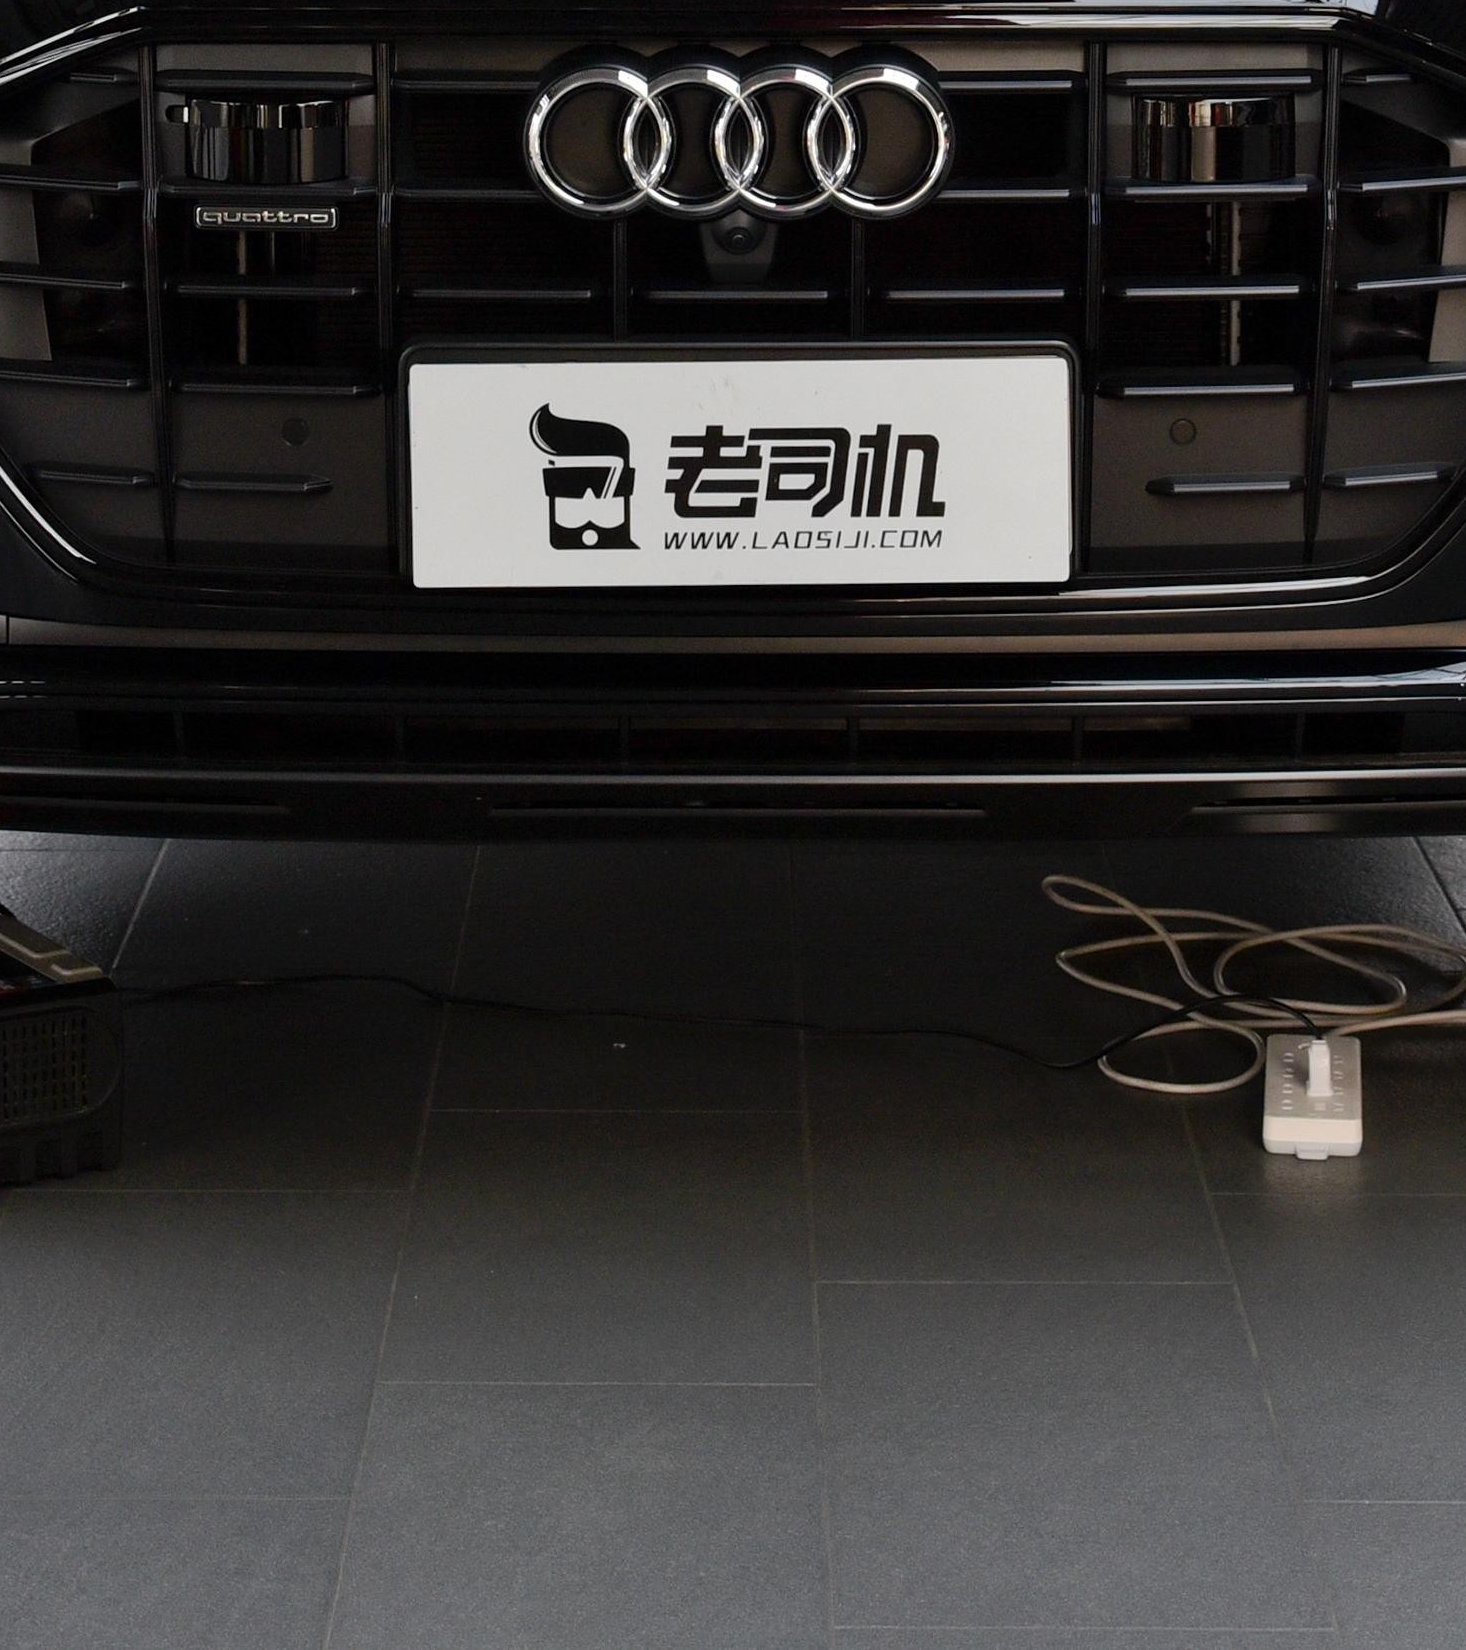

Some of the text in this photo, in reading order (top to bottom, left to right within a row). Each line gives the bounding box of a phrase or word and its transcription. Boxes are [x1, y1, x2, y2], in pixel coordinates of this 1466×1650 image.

[202, 210, 329, 225] quattro
[664, 424, 946, 518] 老司机
[664, 530, 943, 550] WWW.LAOSIJI.COM
